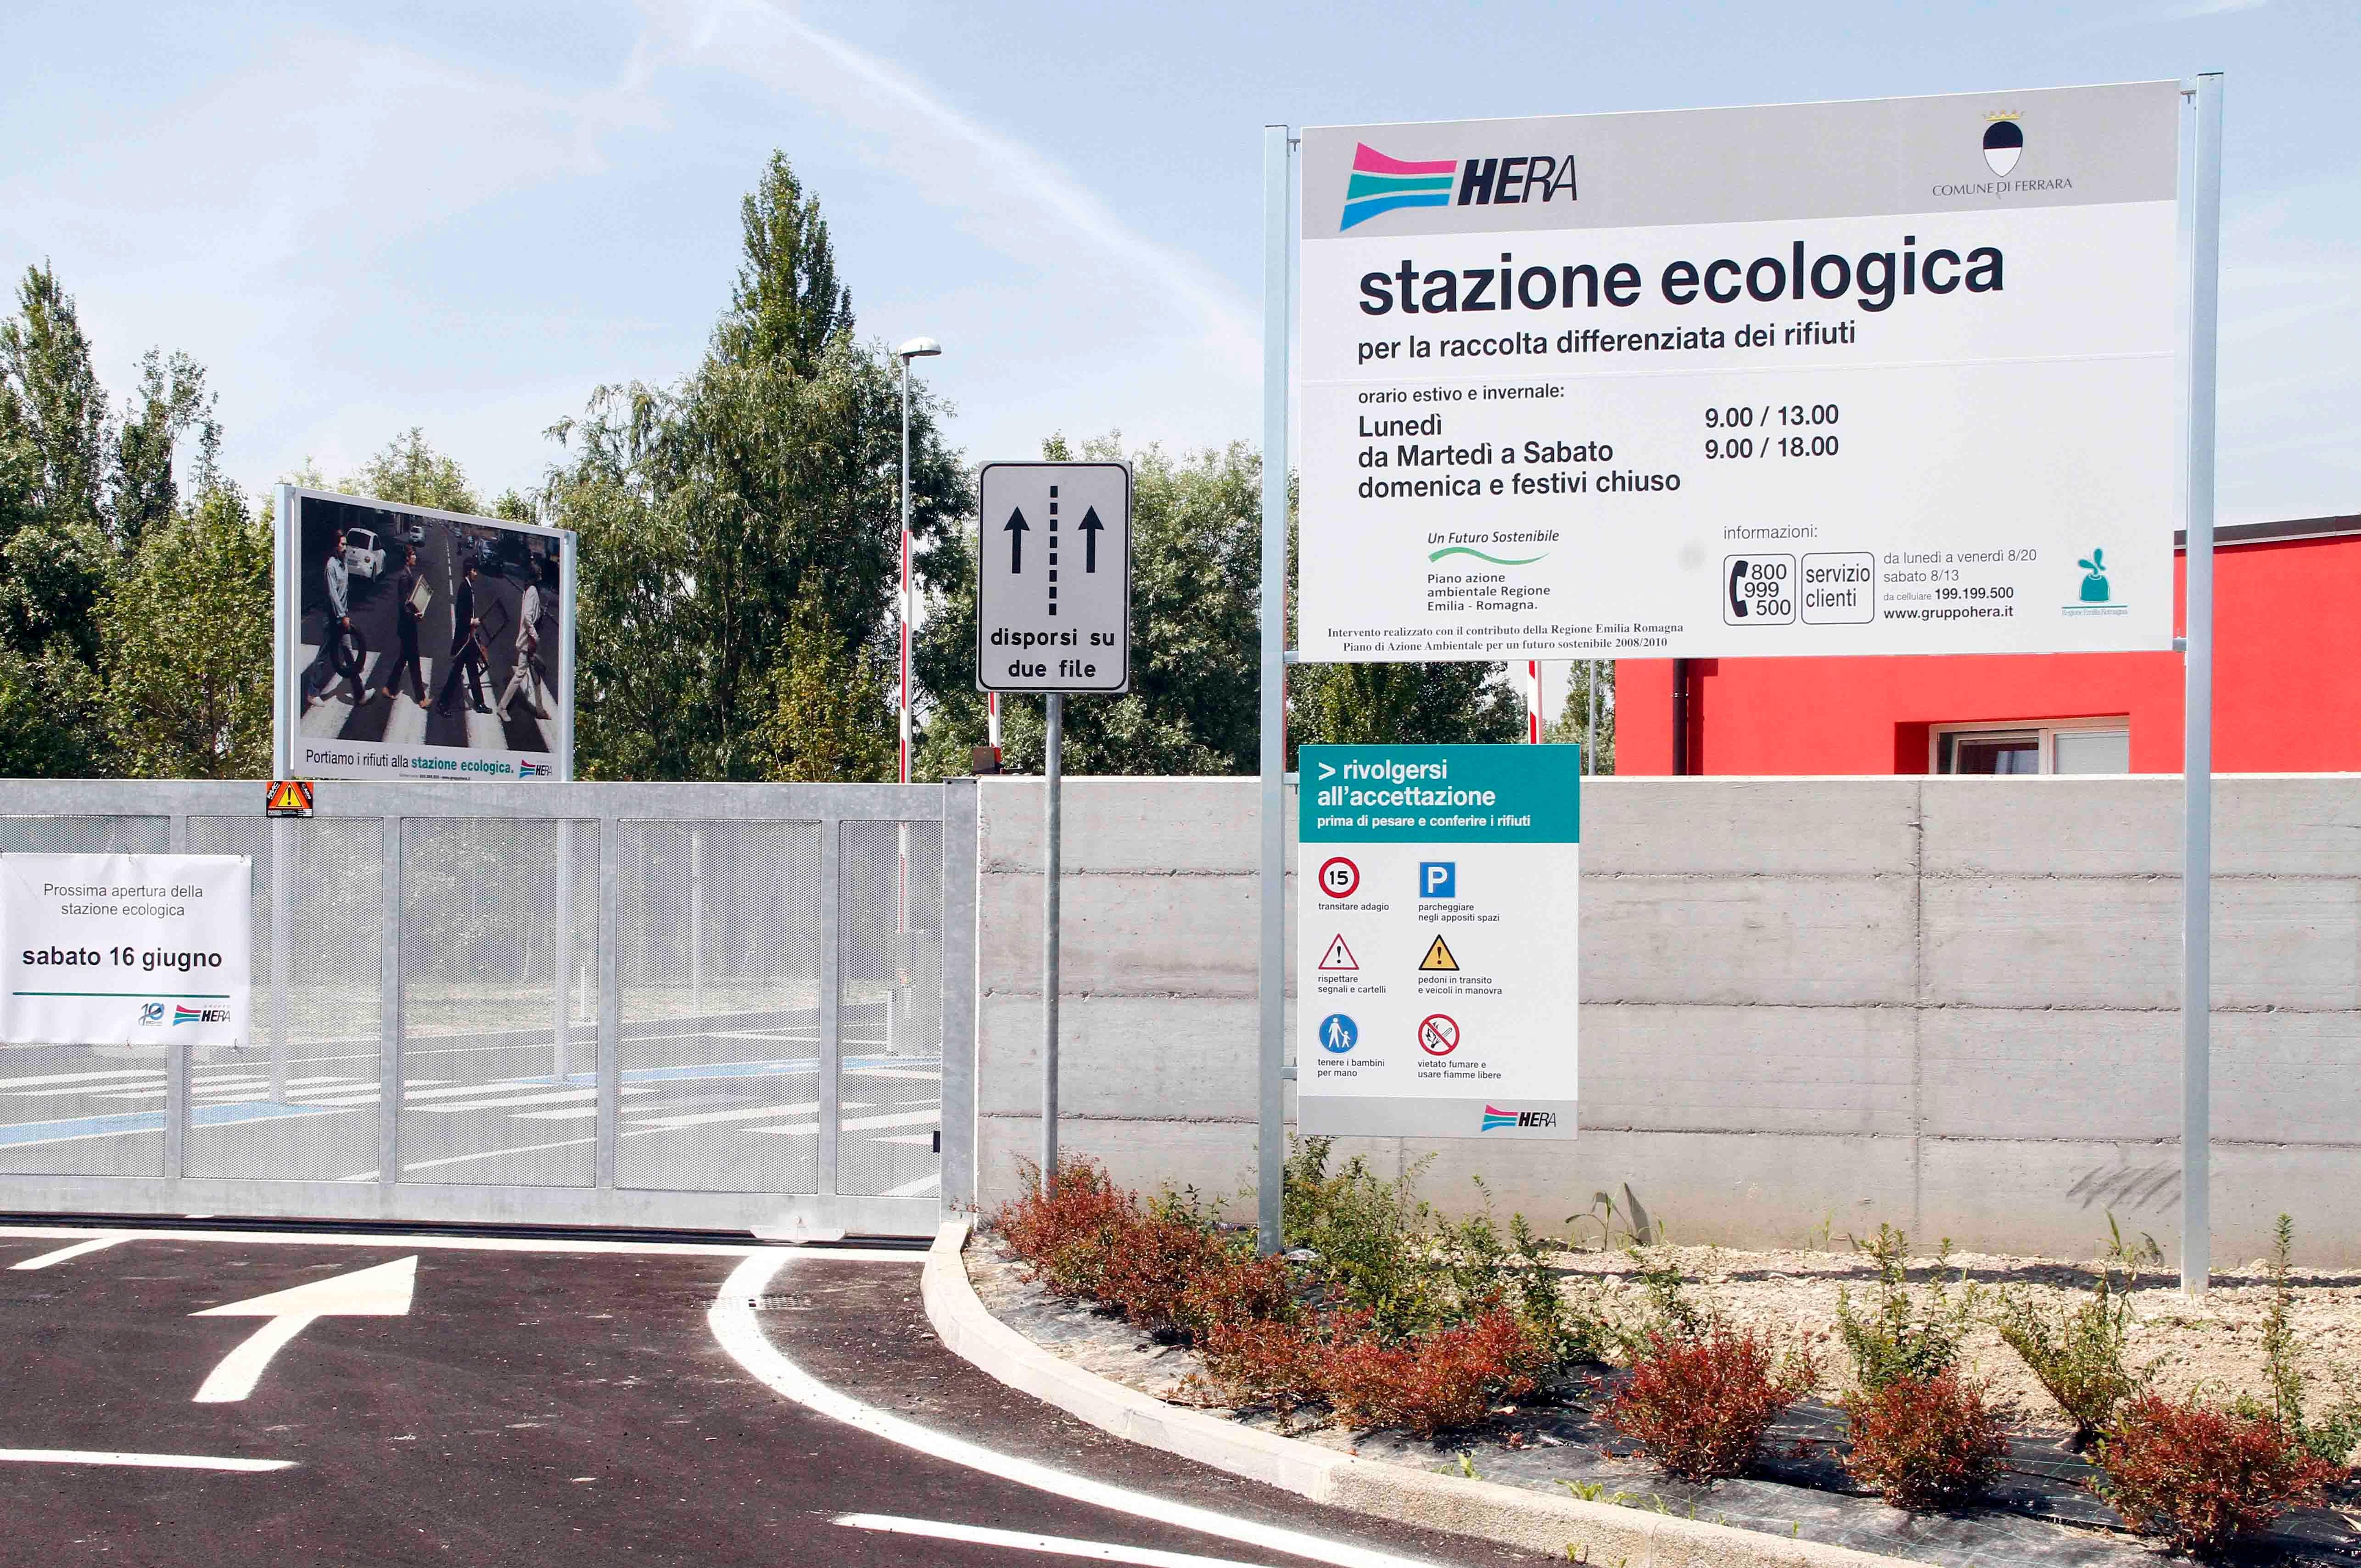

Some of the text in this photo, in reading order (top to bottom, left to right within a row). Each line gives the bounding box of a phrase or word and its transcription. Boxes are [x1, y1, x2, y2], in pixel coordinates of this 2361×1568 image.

[1457, 155, 1578, 206] HERA
[1933, 179, 2072, 196] COMUNE DI FERRARA
[1360, 236, 2003, 316] stazione ecologica
[1359, 320, 1855, 365] per la raccolta differenziata dei rifiuti
[1359, 383, 1564, 403] orario estivo e invernale:
[1706, 407, 1753, 428] 9.00
[1779, 404, 1839, 426] 13.00
[1360, 414, 1441, 437] Lunedì
[1359, 441, 1613, 468] da Martedì a Sabato
[1706, 438, 1753, 459] 9.00
[1778, 436, 1839, 457] 18.00
[1359, 470, 1680, 498] domenica e festivi chiuso
[1428, 530, 1560, 544] Un Futuro Sostenibile
[1724, 524, 1817, 539] informazioni:
[1884, 549, 2037, 564] da lunedì a venerdì 8/20
[1428, 573, 1506, 584] Piano azione
[1751, 564, 1787, 581] 800
[1806, 564, 1871, 583] servizio
[1884, 570, 1959, 582] sabato 8/13
[1428, 586, 1550, 598] ambientale Regione
[1744, 582, 1779, 599] 999
[1806, 588, 1857, 608] clienti
[1897, 593, 1932, 601] cellulare
[1935, 587, 2014, 599] 199.199.500
[1428, 601, 1465, 611] Emilia
[1477, 600, 1538, 612] Romagna.
[1756, 599, 1791, 616] 500
[1884, 605, 2014, 621] www.gruppohera.it
[1329, 628, 1381, 637] Intervento
[1384, 627, 1432, 636] realizzato
[1457, 627, 1463, 636] il
[1466, 626, 1520, 635] contributo
[1523, 626, 1548, 634] della
[1552, 625, 1592, 636] Regione
[1596, 624, 1629, 633] Emilia
[1634, 624, 1683, 634] Romagna
[991, 628, 1114, 650] disporsi su
[1344, 643, 1372, 651] Piano
[1375, 643, 1384, 651] di
[1389, 642, 1421, 651] Azione
[1427, 641, 1483, 650] Ambientale
[1487, 643, 1503, 652] per
[1523, 640, 1555, 649] futuro
[1558, 639, 1612, 648] sostenibile
[1616, 638, 1667, 647] 2008/2010
[1009, 660, 1096, 678] due file
[307, 749, 514, 775] Portiamo i rifiuti alla stazione ecologica.
[536, 765, 552, 776] HERA
[1344, 759, 1447, 784] rivolgersi
[1318, 815, 1530, 829] prima di pesare e conferire i rifiuti
[1330, 871, 1349, 886] 15
[1428, 867, 1448, 893] P
[45, 884, 202, 899] Prossima apertura della
[62, 903, 185, 919] stazione ecologica
[1361, 903, 1389, 912] adagio
[1419, 903, 1475, 912] parcheggiare
[1419, 913, 1499, 923] negli appositi spazi
[23, 946, 222, 972] sabato 16 giugno
[1318, 975, 1358, 985] rispettare
[1419, 976, 1447, 985] pedoni
[1318, 985, 1348, 995] segnali
[201, 1010, 230, 1022] HERA
[1444, 1070, 1476, 1079] fiamme
[1518, 1112, 1556, 1127] HERA
